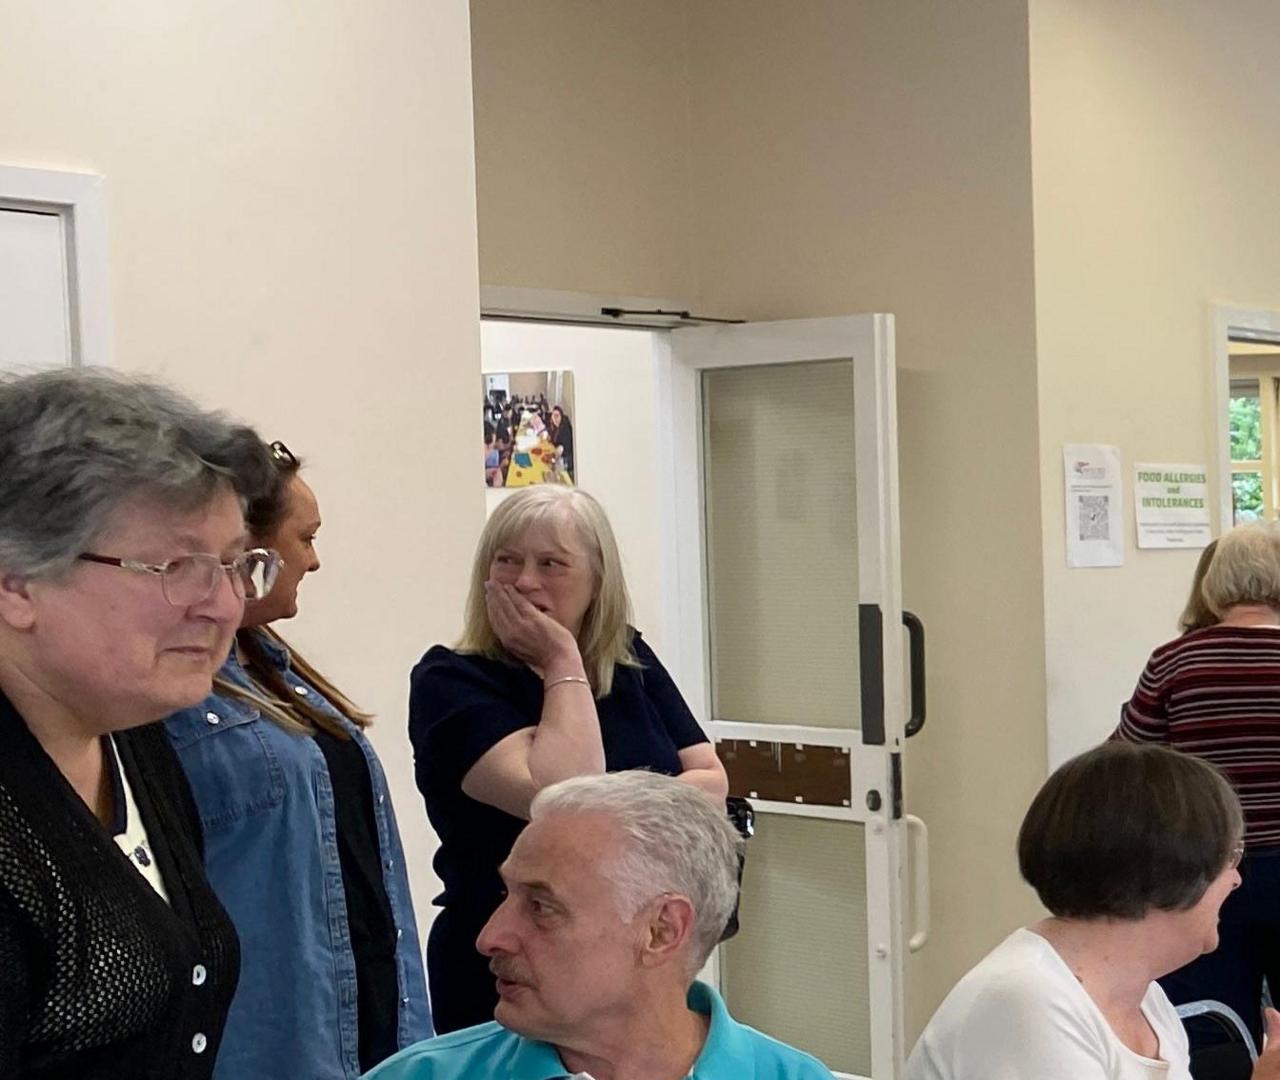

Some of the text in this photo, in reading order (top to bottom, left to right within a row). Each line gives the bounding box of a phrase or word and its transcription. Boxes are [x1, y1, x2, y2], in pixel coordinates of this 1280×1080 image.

[1137, 471, 1206, 484] FOOD ALLERGIES
[1167, 486, 1180, 494] and
[1142, 497, 1204, 508] INTOLERANCES
